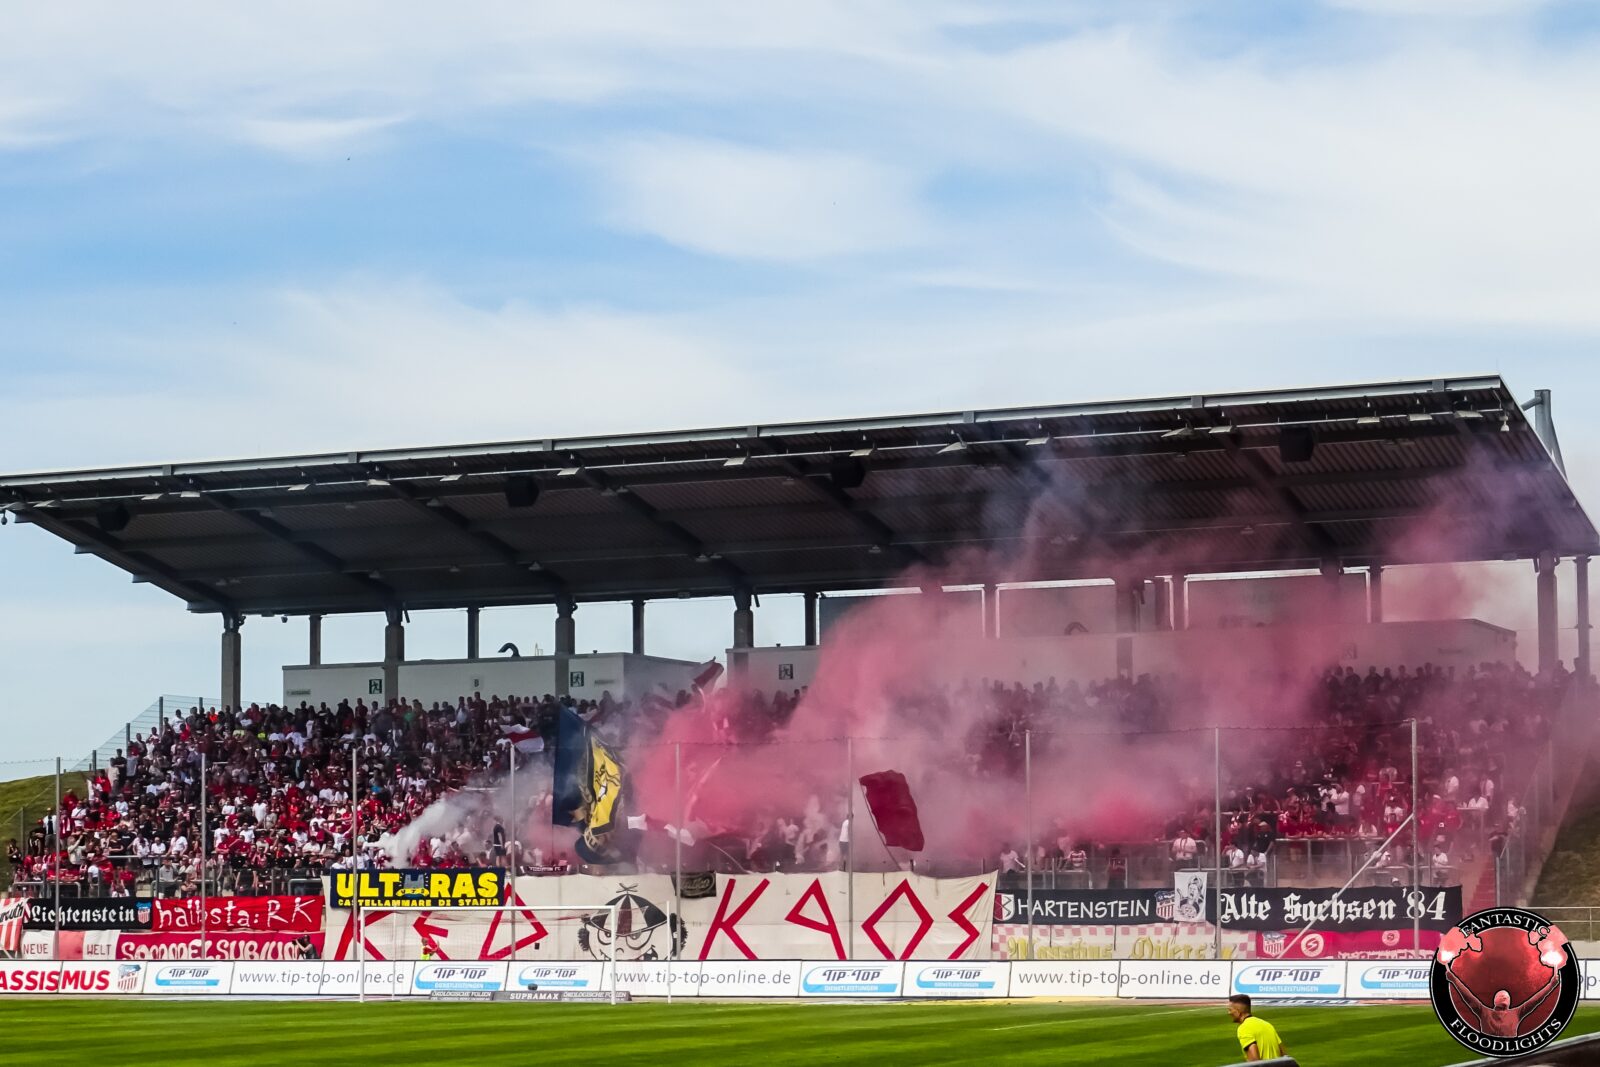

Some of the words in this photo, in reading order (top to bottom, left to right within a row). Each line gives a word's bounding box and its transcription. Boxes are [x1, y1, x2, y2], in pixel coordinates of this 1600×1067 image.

[336, 872, 498, 898] ULTRAS
[338, 898, 432, 907] CATELLAMMARE
[438, 899, 451, 907] DI
[459, 898, 499, 906] STABIA
[1018, 898, 1150, 920] HARTENSTEIN
[1220, 892, 1272, 924] Alte
[1283, 892, 1397, 924] Sachsen
[31, 905, 135, 926] Lichtenstein
[698, 878, 988, 960] KAOS
[23, 944, 49, 955] NEUE
[87, 944, 112, 955] WELT
[239, 970, 405, 986] www.tip-top-onlne.de
[1019, 970, 1221, 987] www.tip-top-online.de
[509, 992, 559, 1000] SUPRAMAX
